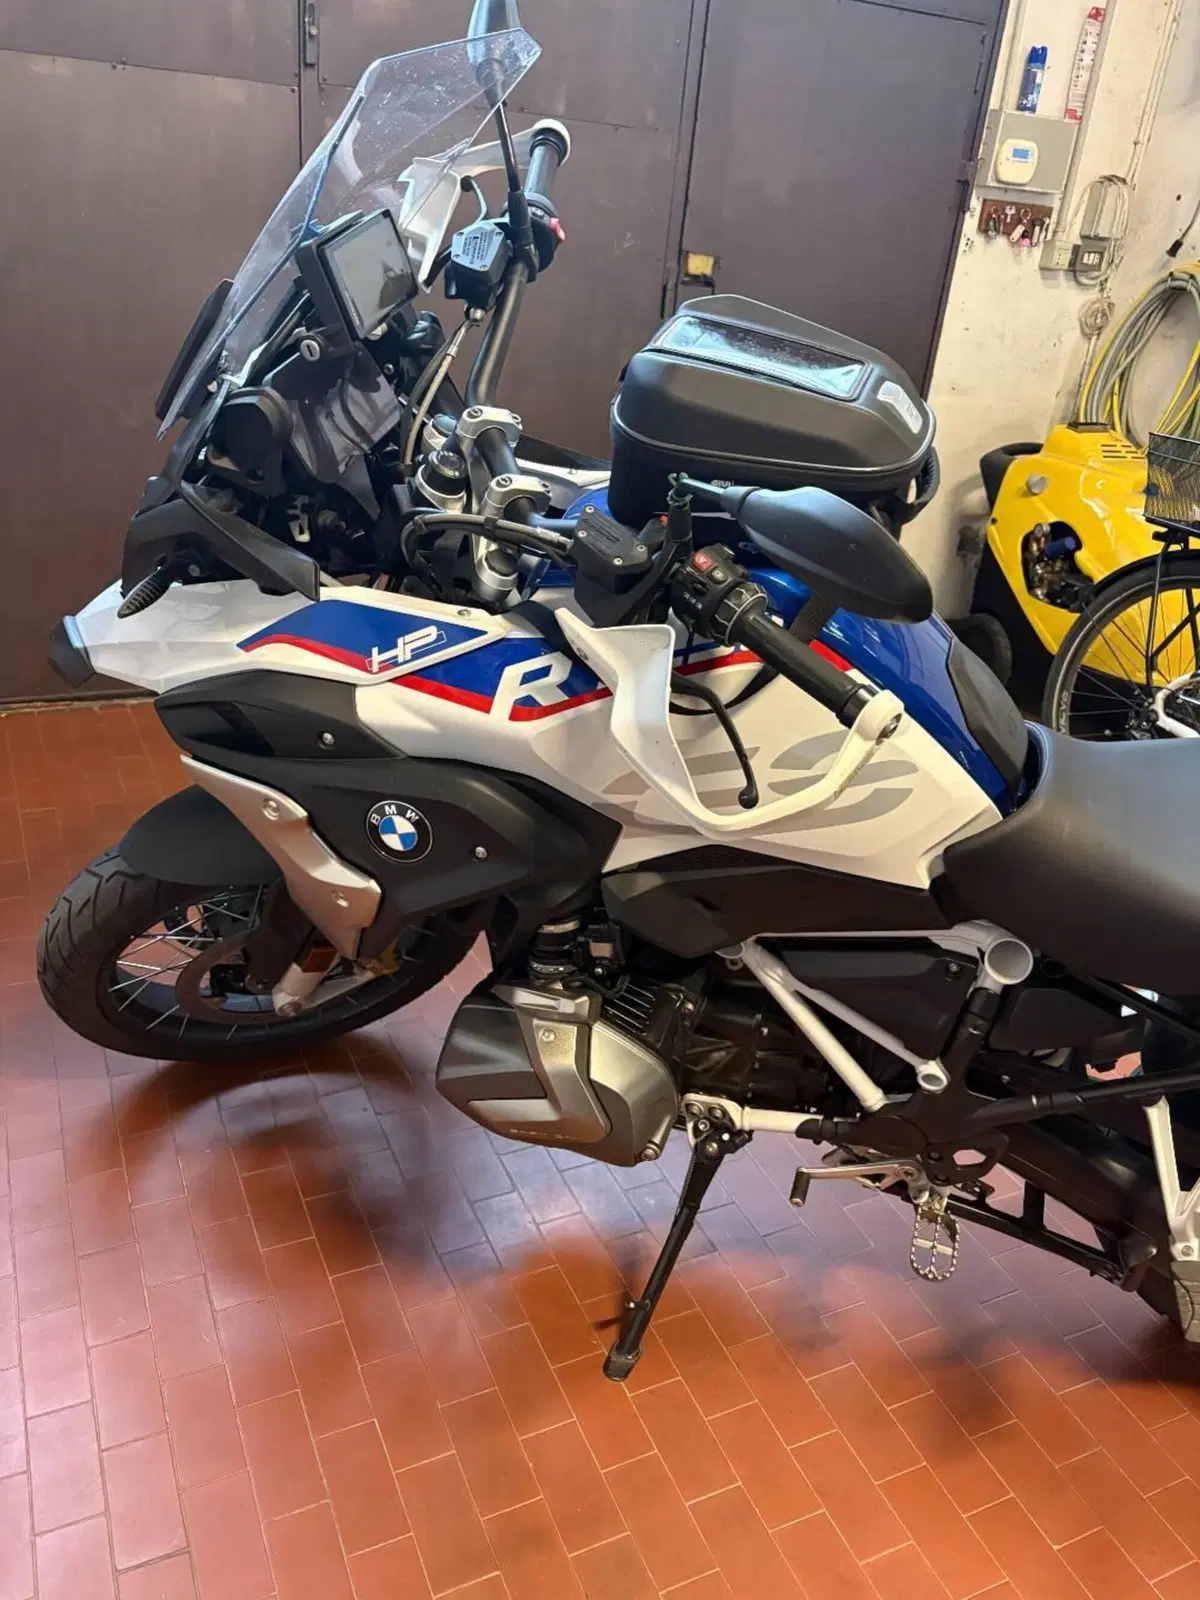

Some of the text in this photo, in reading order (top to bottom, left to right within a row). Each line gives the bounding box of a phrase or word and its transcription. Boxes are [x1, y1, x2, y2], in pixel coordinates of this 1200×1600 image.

[367, 625, 446, 673] HP
[489, 651, 573, 723] R
[370, 804, 420, 826] BMW
